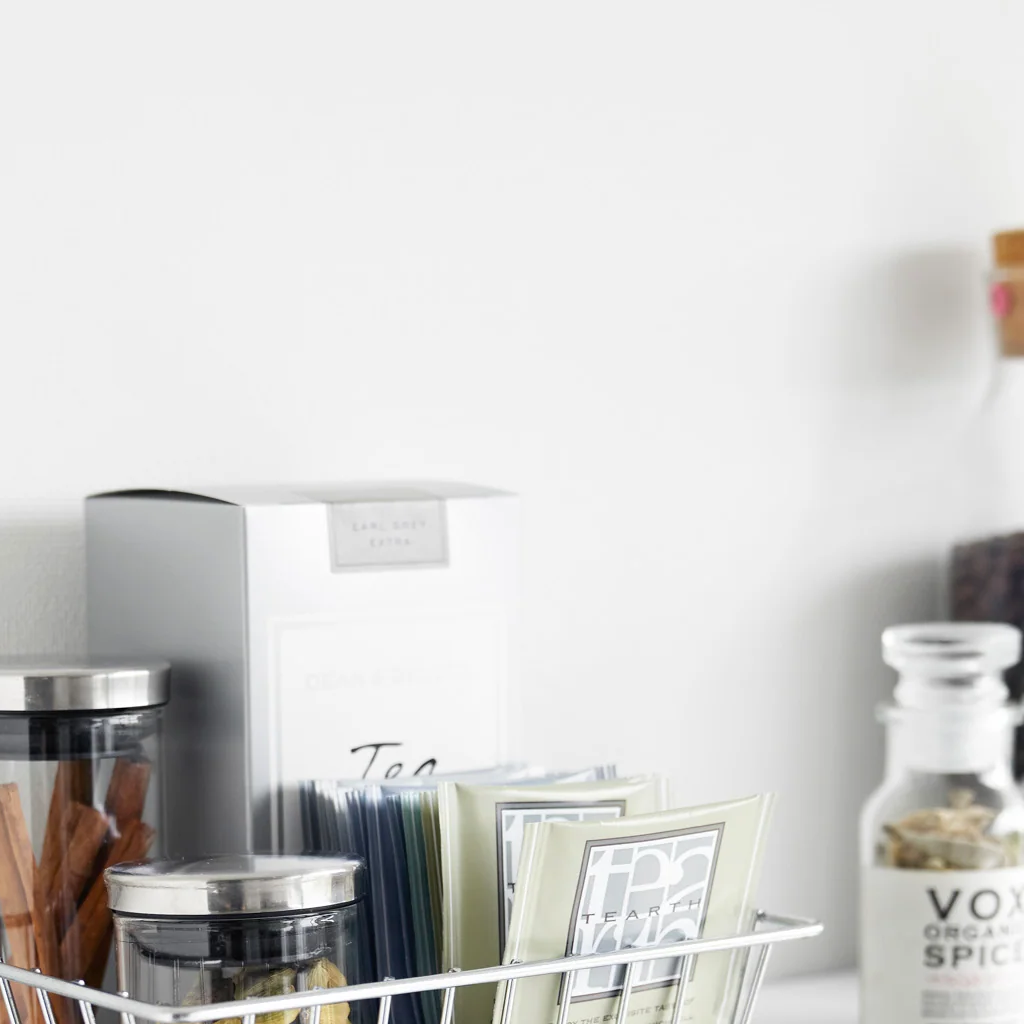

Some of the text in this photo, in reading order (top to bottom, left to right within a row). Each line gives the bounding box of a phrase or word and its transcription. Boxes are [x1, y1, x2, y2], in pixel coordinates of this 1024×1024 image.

[581, 898, 702, 925] TEARTH
[924, 924, 1018, 941] ORGAN
[602, 1006, 652, 1022] EXISITE
